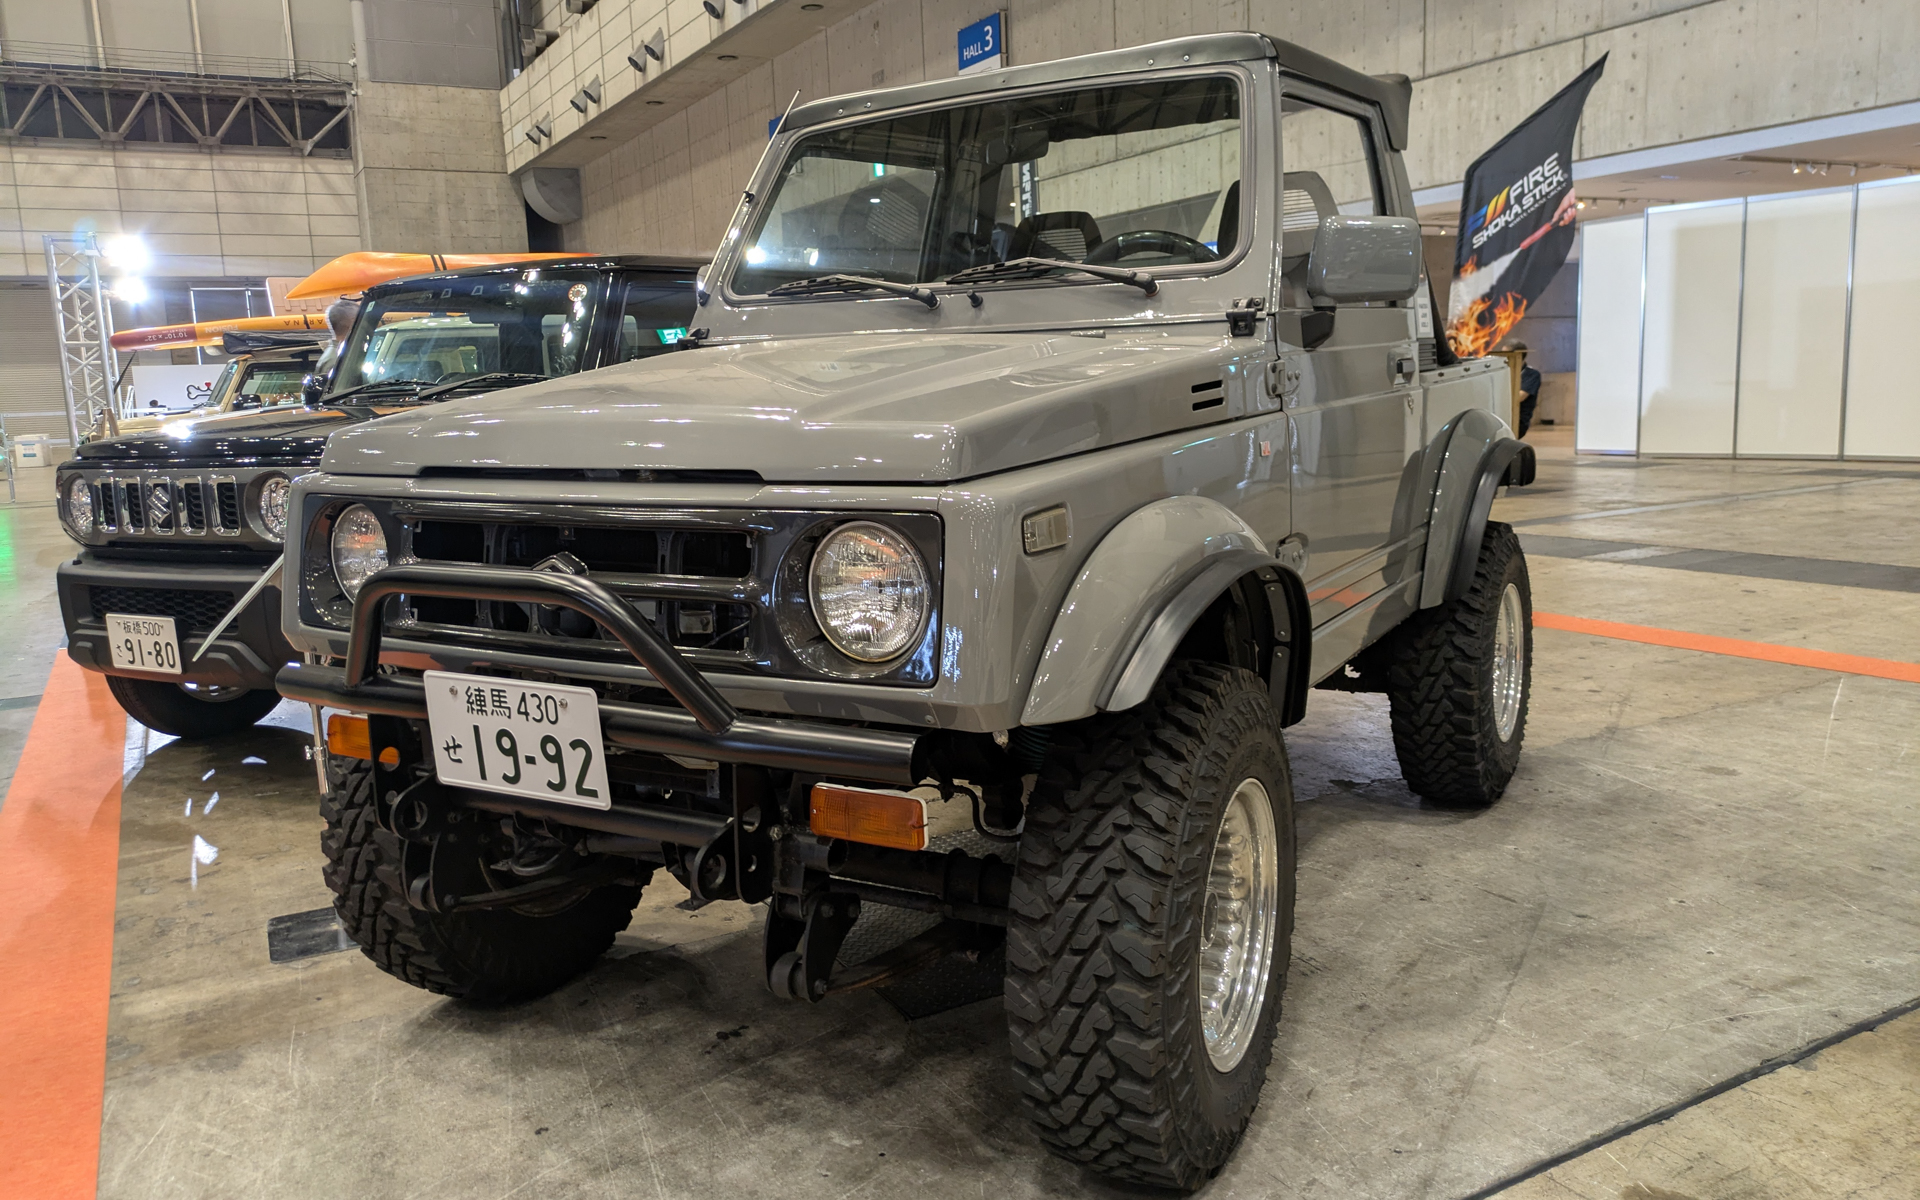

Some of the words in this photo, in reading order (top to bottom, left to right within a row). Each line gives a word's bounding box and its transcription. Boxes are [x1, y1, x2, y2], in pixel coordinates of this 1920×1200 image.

[963, 41, 983, 61] HALL
[984, 25, 993, 52] 3
[1509, 152, 1560, 205] FIRE
[1472, 203, 1522, 249] SHOKA
[1522, 170, 1564, 210] STICK
[205, 324, 239, 333] FUSION
[124, 638, 176, 669] 91-80
[465, 685, 512, 719] 練馬
[517, 691, 559, 725] 430
[442, 734, 463, 764] せ
[472, 723, 599, 799] 19-92
